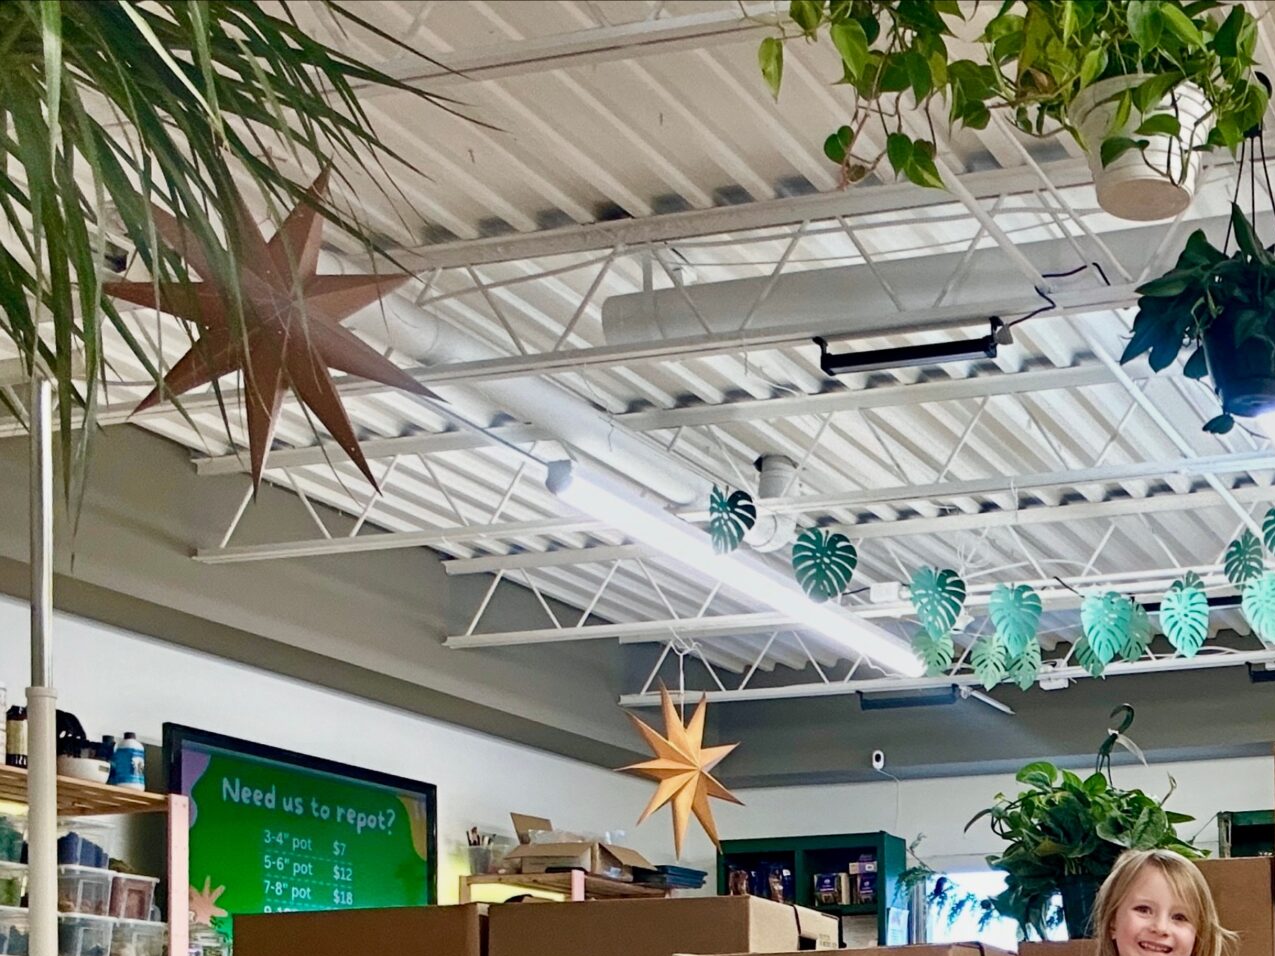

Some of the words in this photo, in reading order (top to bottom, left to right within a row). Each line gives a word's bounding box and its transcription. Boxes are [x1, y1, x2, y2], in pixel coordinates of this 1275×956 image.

[222, 777, 276, 809] Need
[283, 795, 304, 815] us
[310, 799, 330, 820] to
[336, 805, 396, 836] repot?
[264, 829, 290, 846] 3-4"
[292, 836, 313, 852] pot
[333, 840, 346, 856] $7
[264, 855, 290, 871] 5-6"
[293, 860, 313, 876] pot
[333, 865, 353, 882] $12
[264, 880, 289, 896] 7-8"
[291, 884, 312, 900] pot
[333, 889, 353, 905] $18
